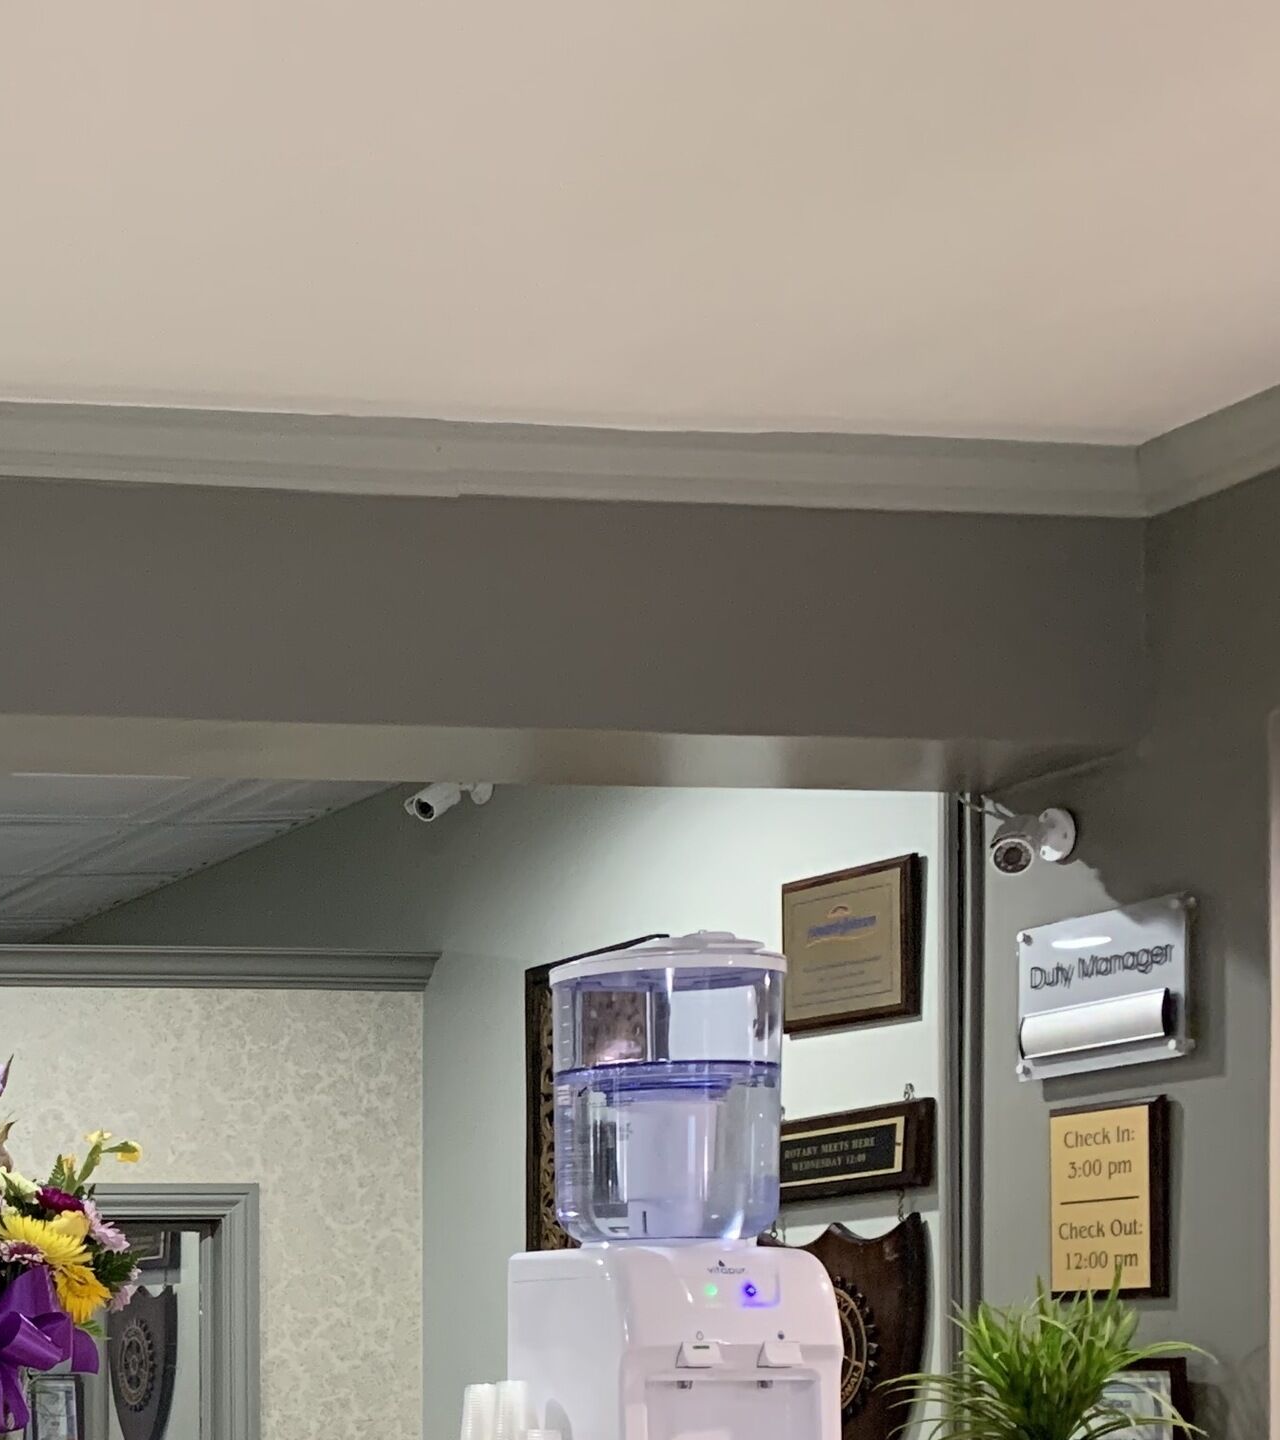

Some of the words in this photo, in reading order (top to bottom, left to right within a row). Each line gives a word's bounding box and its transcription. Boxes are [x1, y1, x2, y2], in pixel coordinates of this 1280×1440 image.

[1030, 962, 1075, 989] Duty
[1077, 944, 1174, 980] Manager
[784, 1146, 818, 1159] ROTARY
[821, 1140, 849, 1153] MEETS
[852, 1137, 875, 1149] HERE
[1063, 1128, 1111, 1148] Check
[1116, 1126, 1135, 1143] In:
[1067, 1159, 1102, 1179] 3:00
[1108, 1159, 1132, 1179] pm
[1058, 1221, 1106, 1240] Check
[1110, 1218, 1143, 1237] Out:
[1065, 1251, 1108, 1270] 12:00
